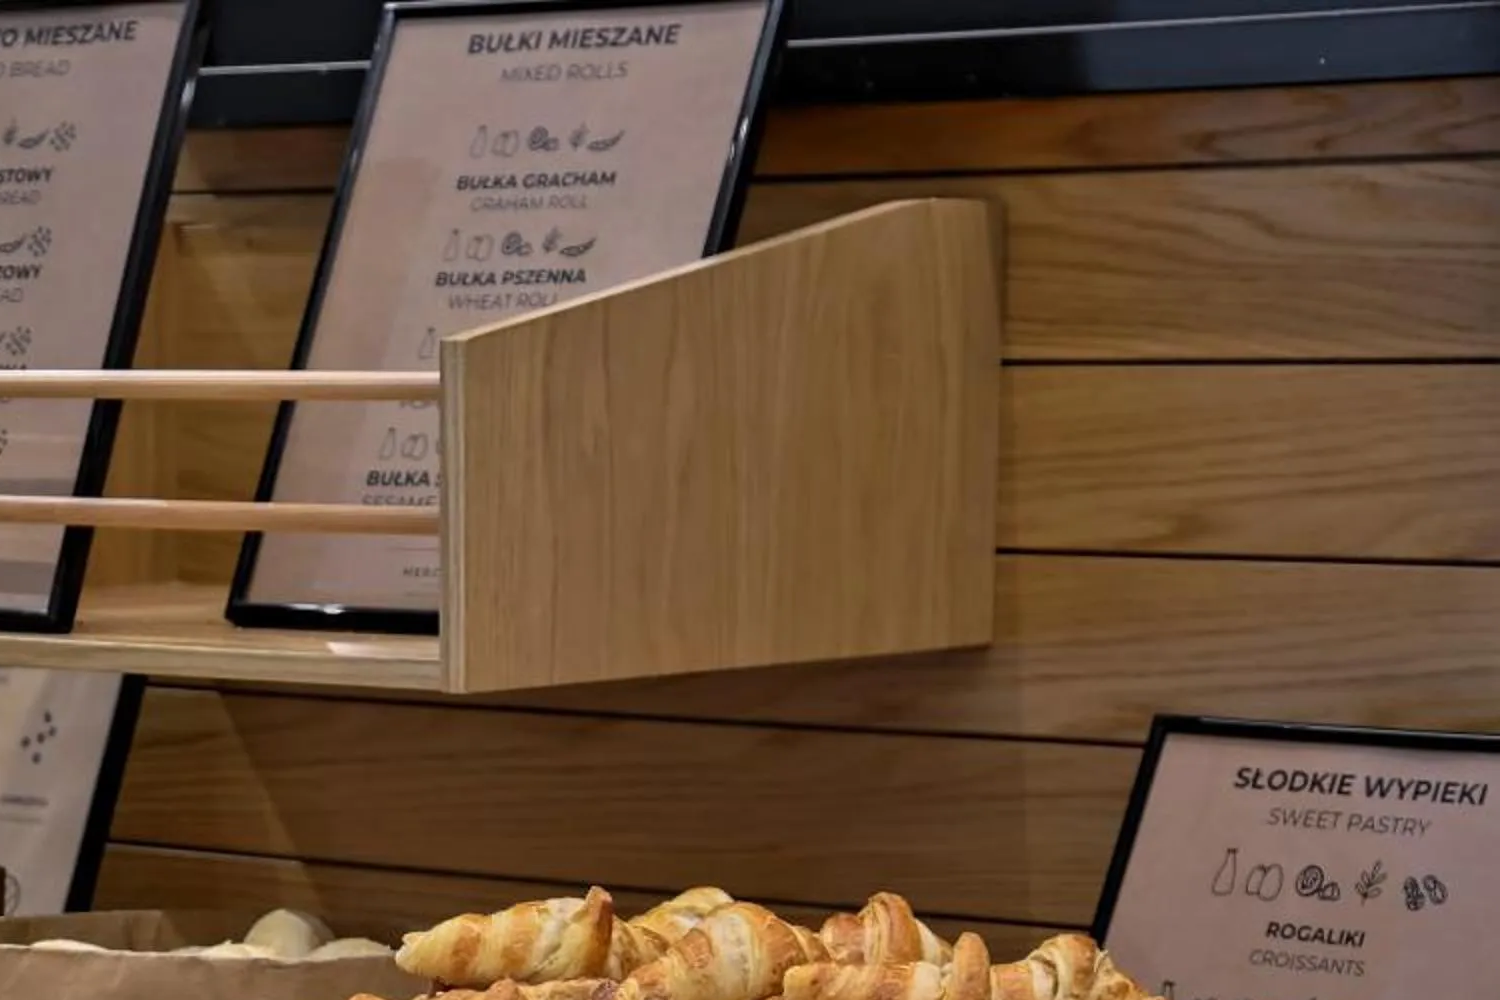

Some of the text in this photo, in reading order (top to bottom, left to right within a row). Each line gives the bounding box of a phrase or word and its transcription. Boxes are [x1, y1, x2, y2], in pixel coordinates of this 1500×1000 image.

[22, 20, 138, 46] MIESZANE
[467, 24, 681, 55] BUŁKI MIESZANE
[10, 59, 71, 78] BREAD
[501, 61, 629, 83] MIXED ROLLS
[456, 170, 617, 191] BUŁKA GRACHAM
[470, 194, 588, 212] GRAHAM ROLL
[434, 268, 586, 288] BUŁKA PSZENNA
[448, 292, 514, 310] WHEAT
[366, 470, 430, 487] BUŁKA
[1234, 767, 1488, 806] SŁODKIE WYPIEKI
[1266, 807, 1432, 838] SWEET PASTRY
[1265, 922, 1365, 948] ROGALIKI
[1249, 949, 1366, 977] CROISSANTS
